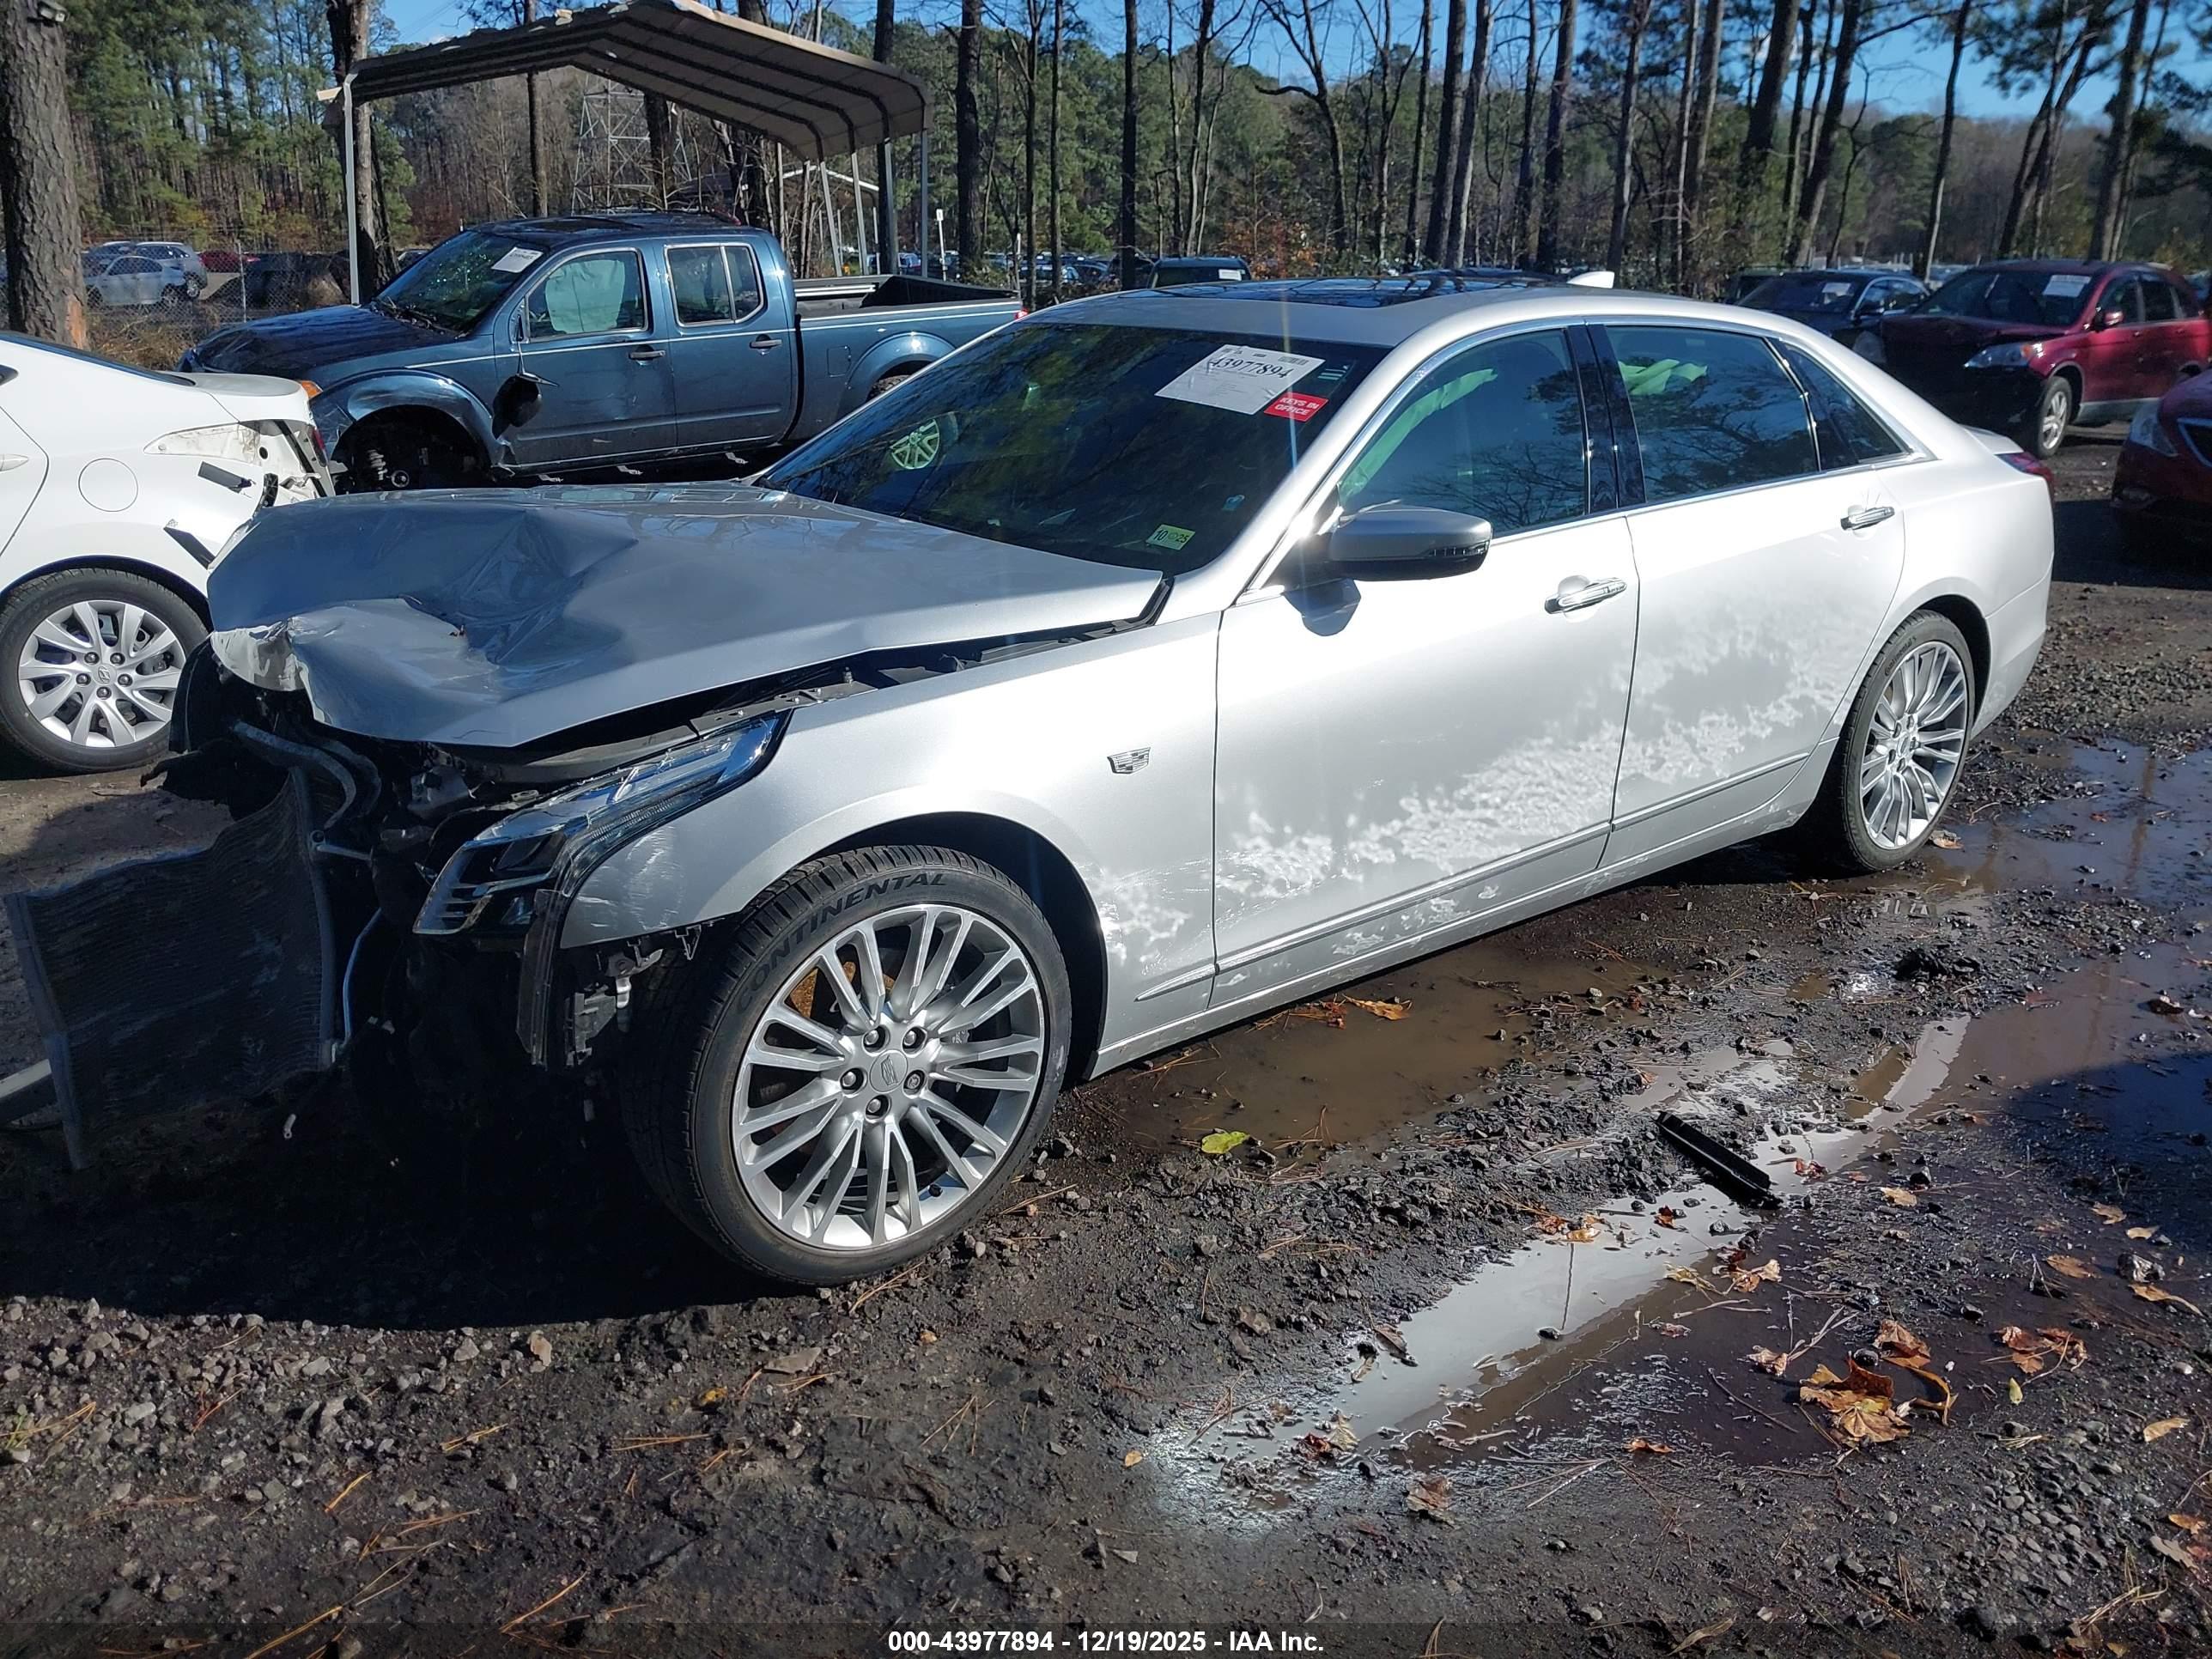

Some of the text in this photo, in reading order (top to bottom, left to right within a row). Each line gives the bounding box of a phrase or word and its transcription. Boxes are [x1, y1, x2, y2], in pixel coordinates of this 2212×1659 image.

[1208, 356, 1295, 379] 43977894
[1279, 398, 1307, 406] KEYS
[1274, 404, 1310, 415] OFFICE
[1153, 529, 1189, 543] 10 25
[737, 872, 948, 1012] CONTINENTAL
